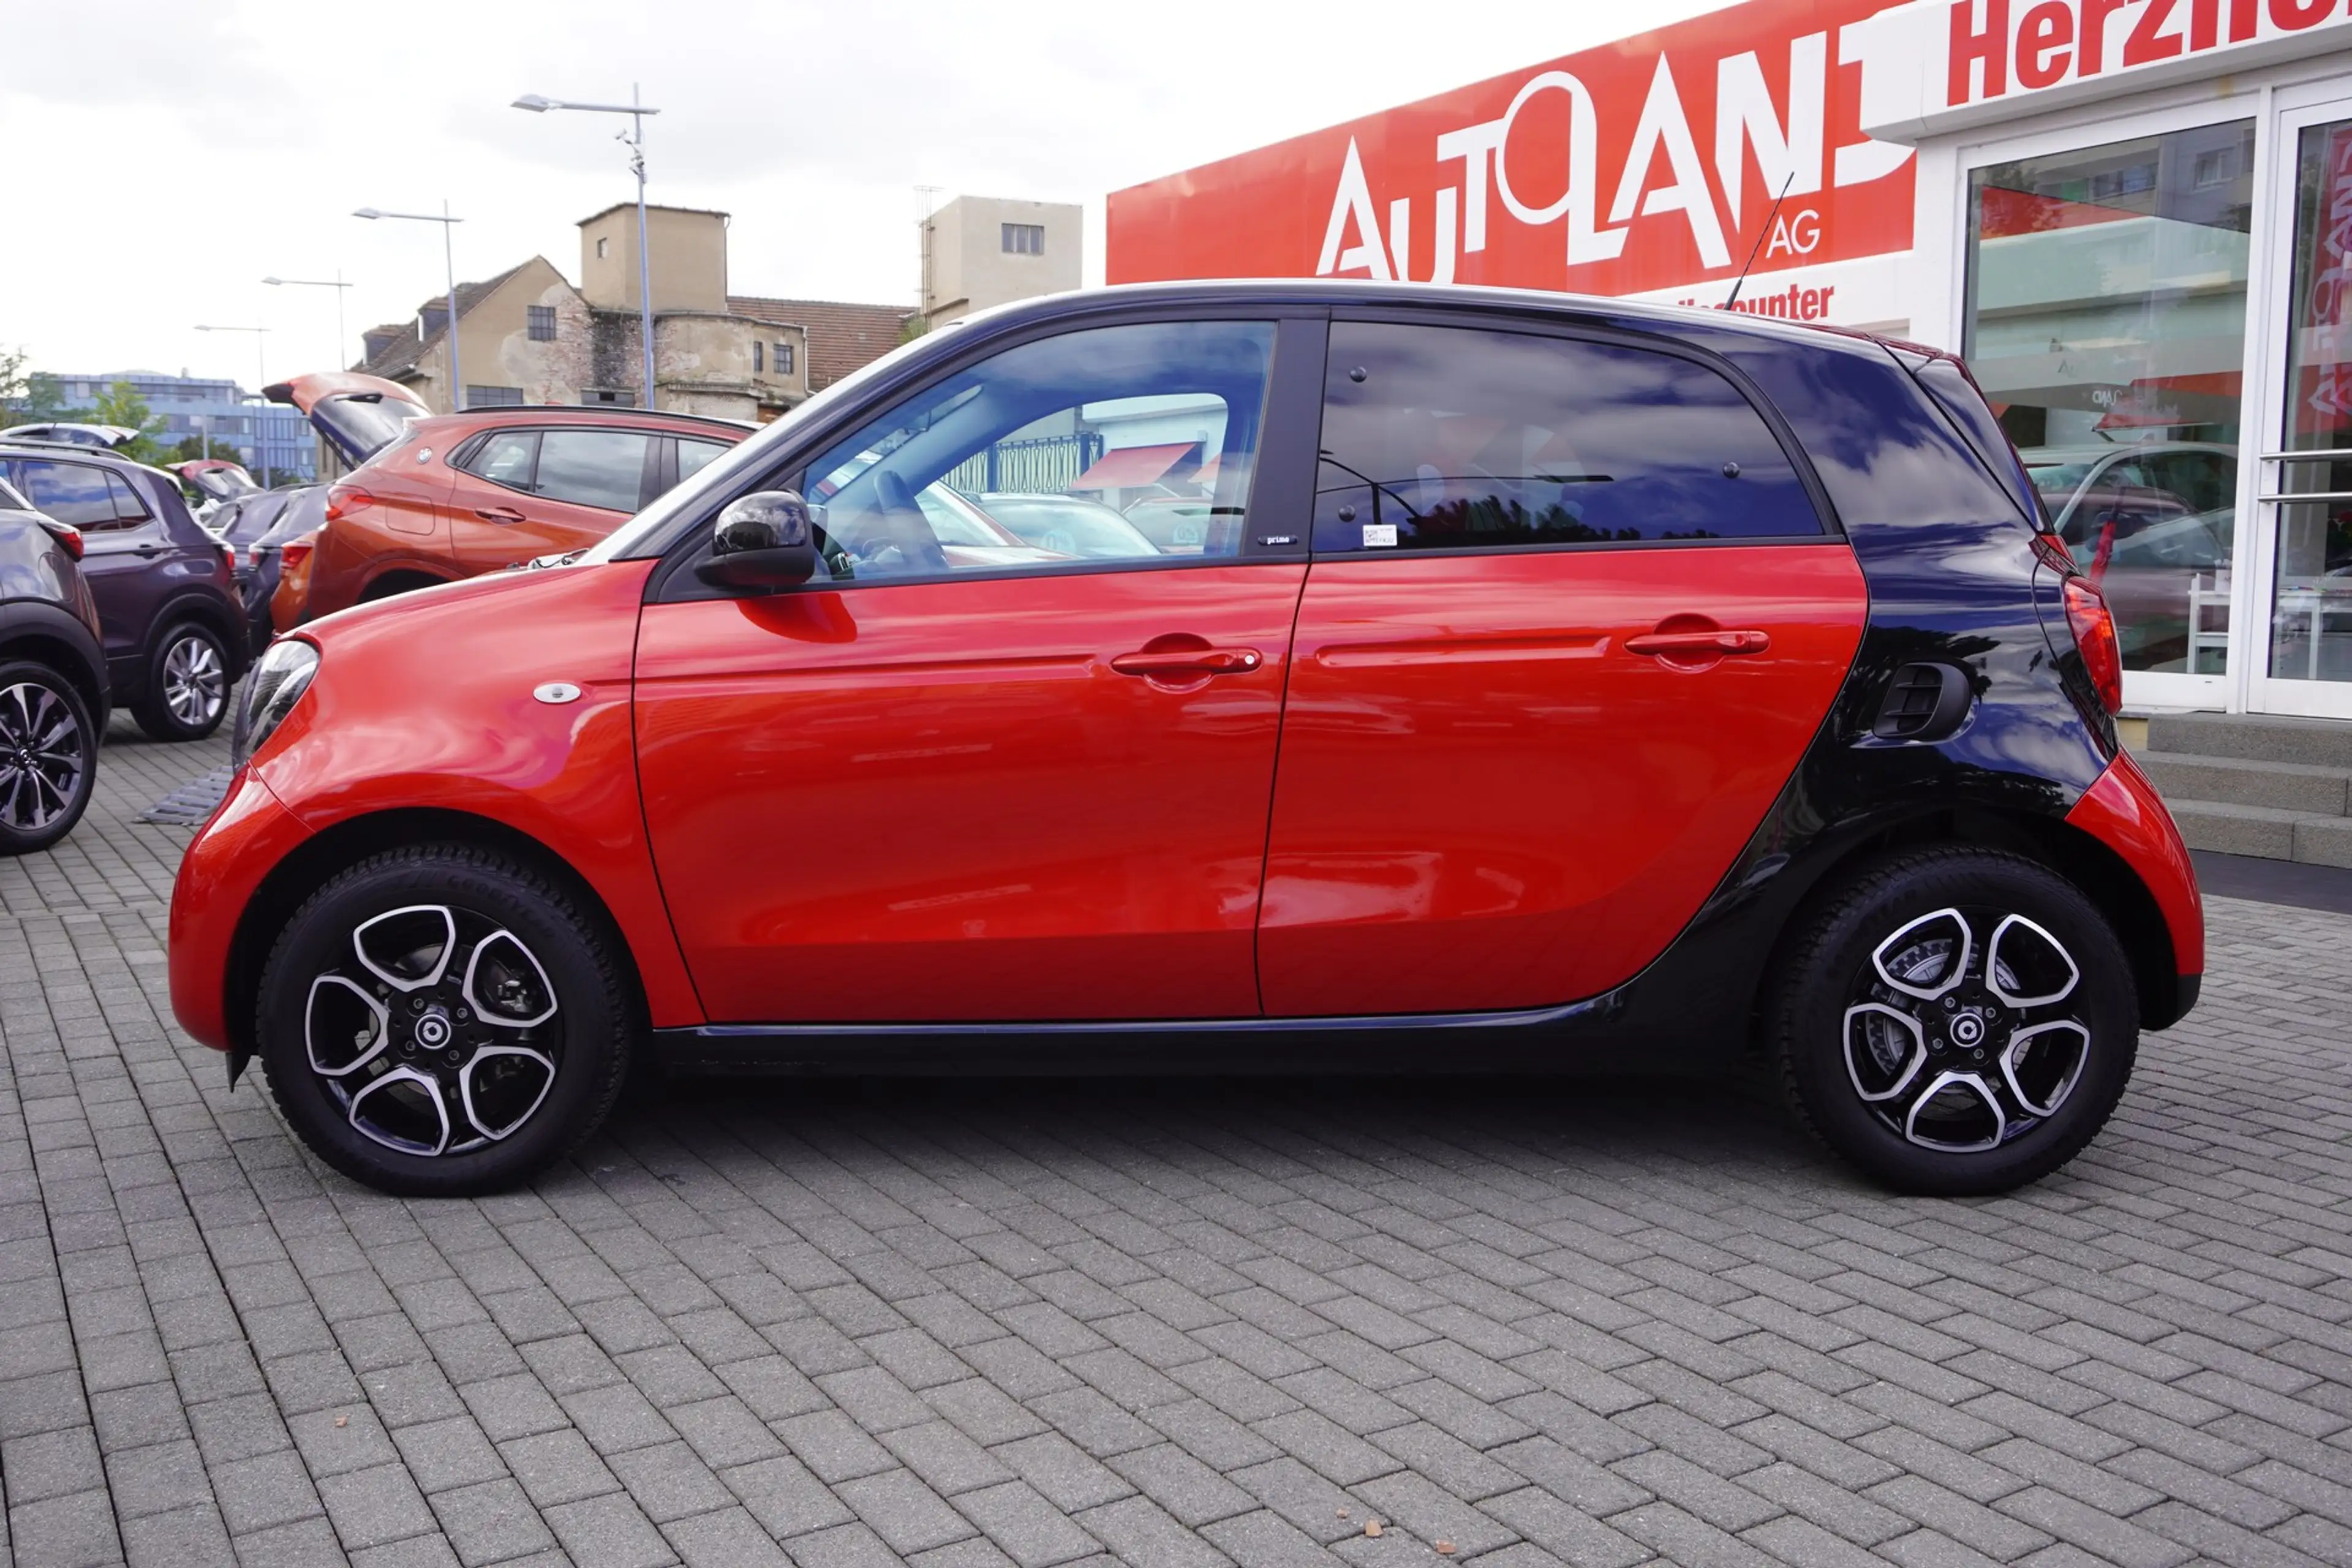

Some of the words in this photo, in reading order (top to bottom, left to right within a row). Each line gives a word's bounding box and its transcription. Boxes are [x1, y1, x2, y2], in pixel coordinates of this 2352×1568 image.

[1948, 0, 2352, 107] Herz
[1766, 209, 1820, 258] AG
[1267, 535, 1290, 545] prime
